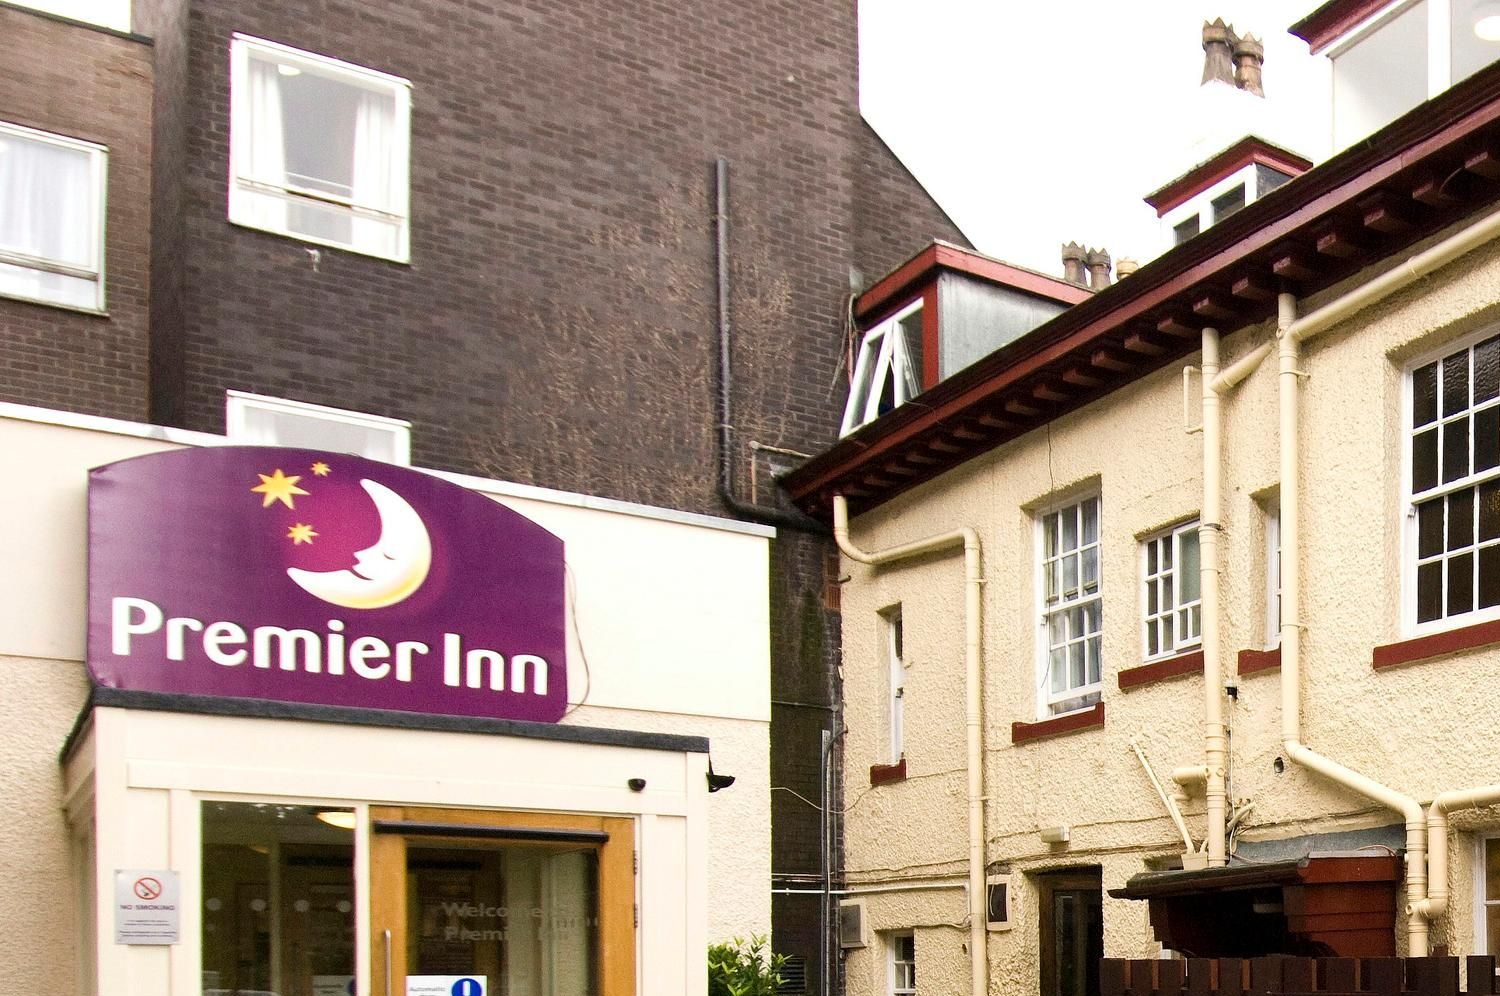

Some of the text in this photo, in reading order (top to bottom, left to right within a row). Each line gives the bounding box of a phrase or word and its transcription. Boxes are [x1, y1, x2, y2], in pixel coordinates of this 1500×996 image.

[111, 596, 549, 696] Premier Inn
[444, 926, 532, 942] Premi
